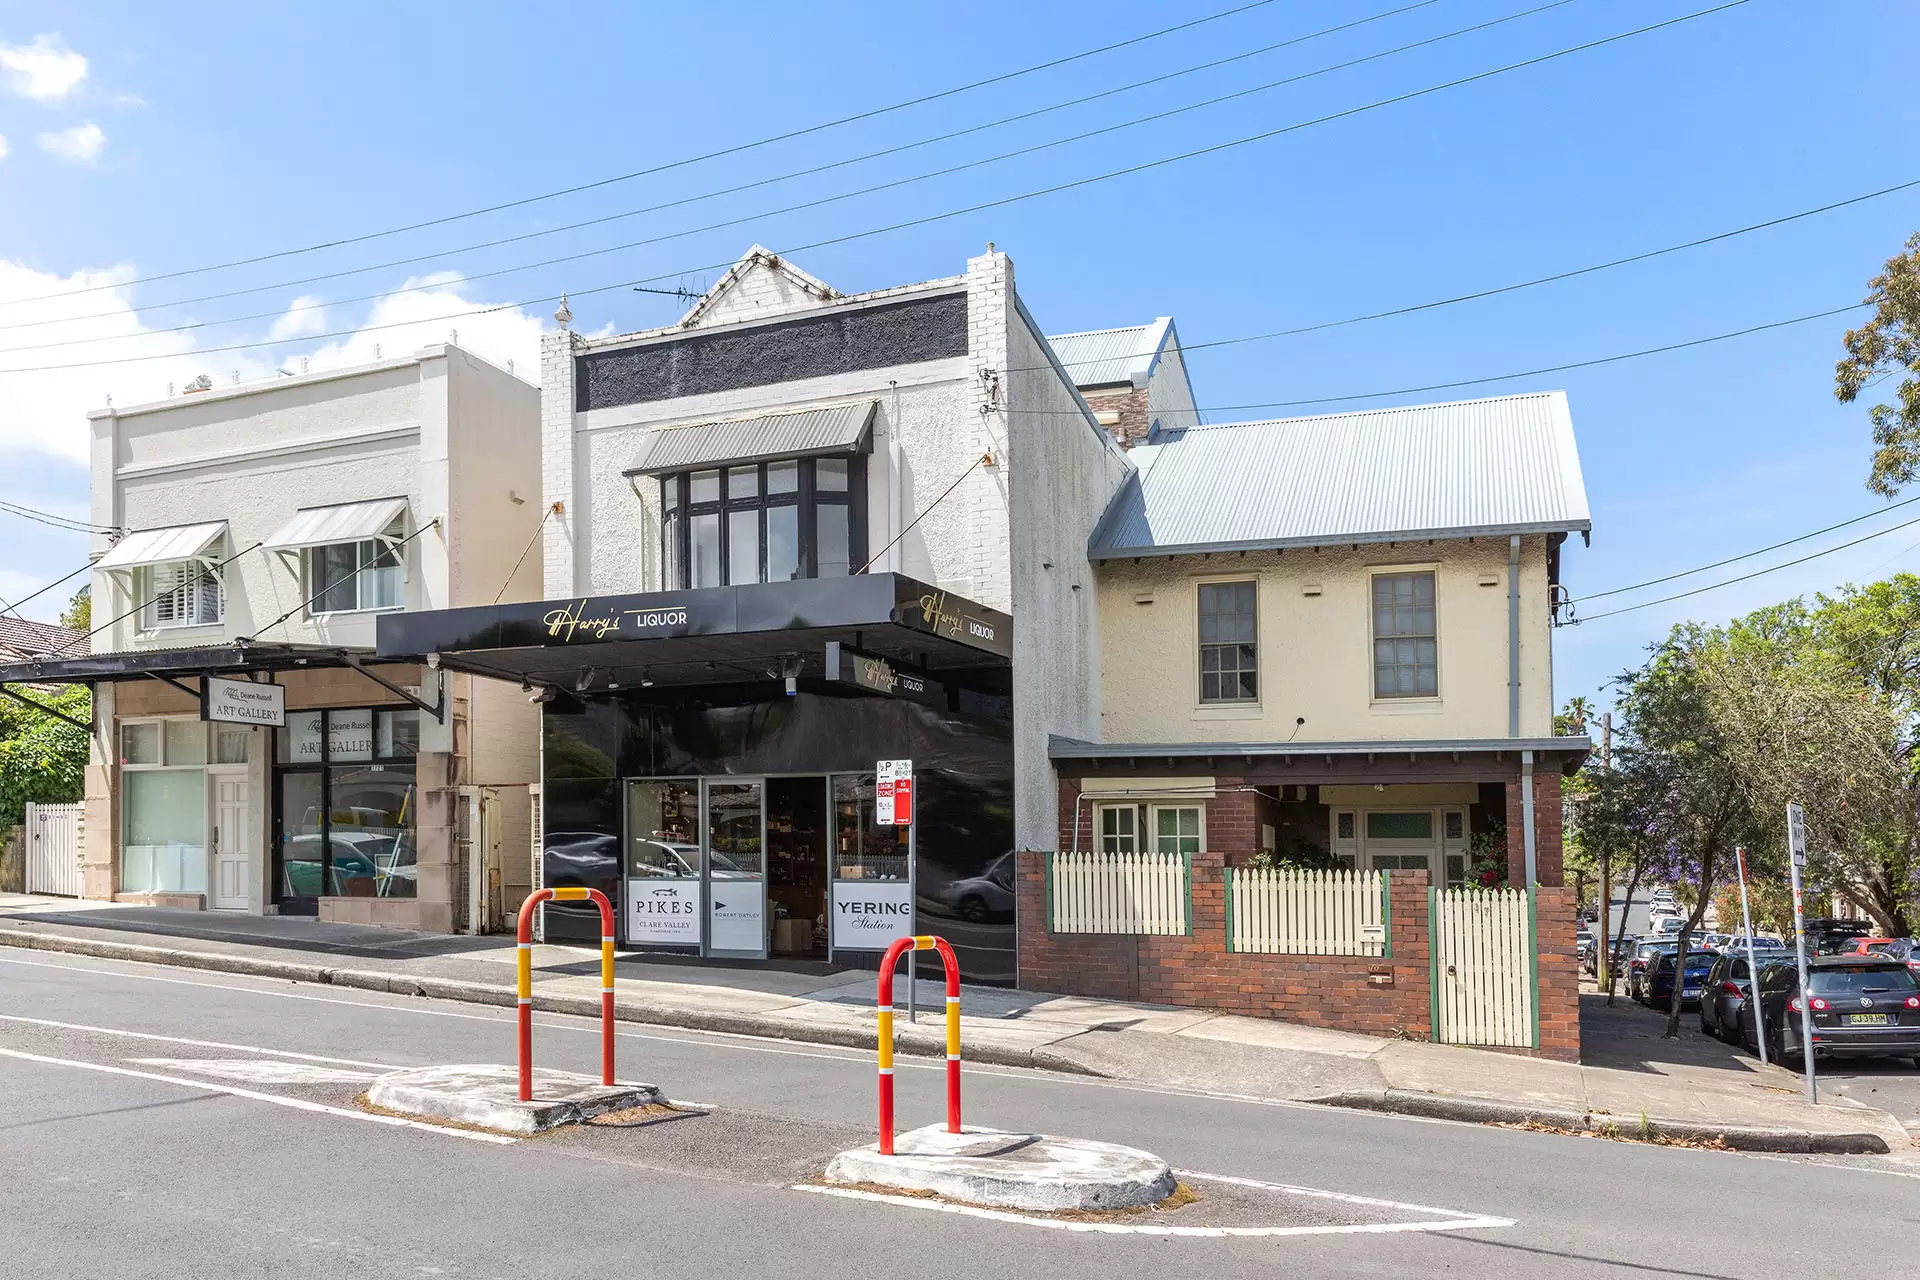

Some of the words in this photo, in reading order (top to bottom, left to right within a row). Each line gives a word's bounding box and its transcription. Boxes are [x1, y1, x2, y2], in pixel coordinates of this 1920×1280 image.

[543, 599, 620, 642] Harry's
[637, 612, 687, 627] LIQUOR
[920, 591, 963, 636] Harry's
[969, 622, 994, 641] LIQUOR
[864, 657, 898, 690] Harry's
[903, 679, 924, 693] LIQUOR
[240, 691, 255, 700] Deane
[256, 692, 272, 701] Russell
[216, 705, 235, 716] ART
[238, 707, 278, 720] GALLERY
[331, 722, 350, 731] Deane
[351, 721, 371, 729] Russel
[300, 742, 322, 754] ART
[328, 740, 373, 753] GALLER
[636, 901, 693, 914] PIKES
[838, 902, 910, 915] YERING
[663, 921, 691, 929] VALLEY
[851, 915, 895, 930] Station
